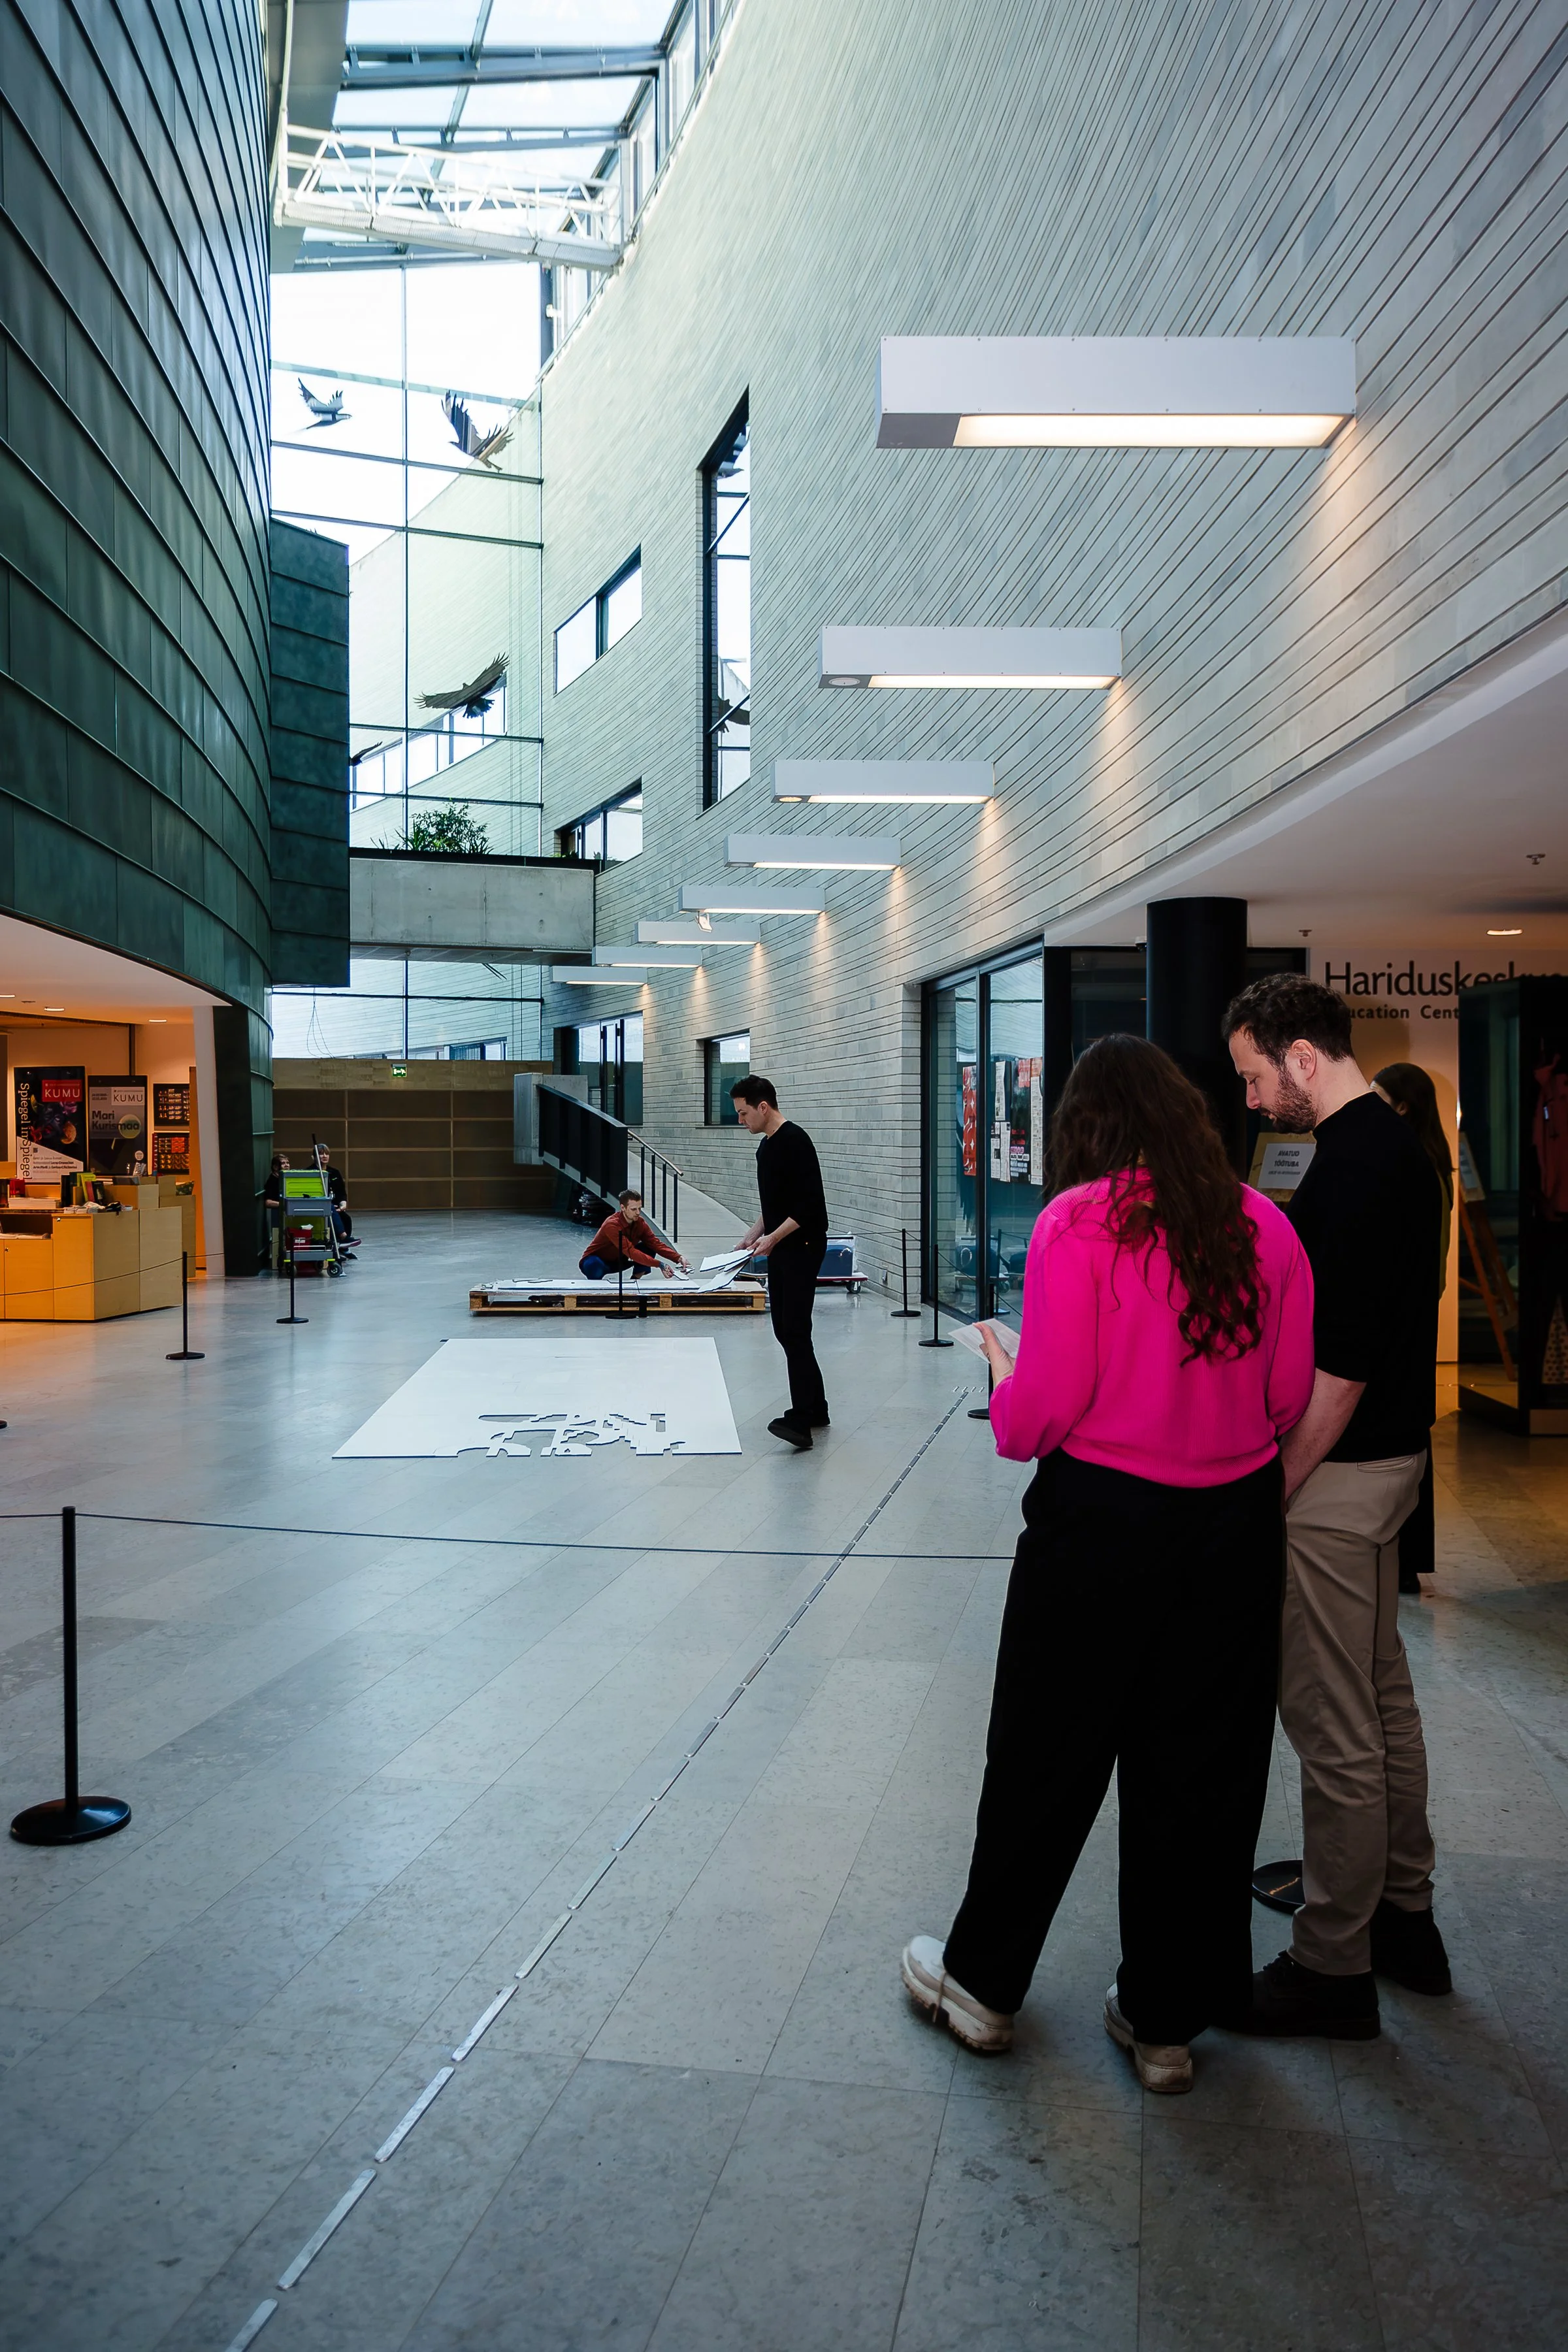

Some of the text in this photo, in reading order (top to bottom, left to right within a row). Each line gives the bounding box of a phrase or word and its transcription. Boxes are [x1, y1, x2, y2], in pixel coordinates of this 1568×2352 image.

[1350, 1004, 1459, 1019] ucation Cent
[45, 1088, 80, 1098] KUMU
[18, 1083, 31, 1124] Spiegel
[92, 1111, 114, 1120] Mari
[92, 1120, 139, 1130] Kurismaa
[20, 1140, 33, 1180] Spiegel
